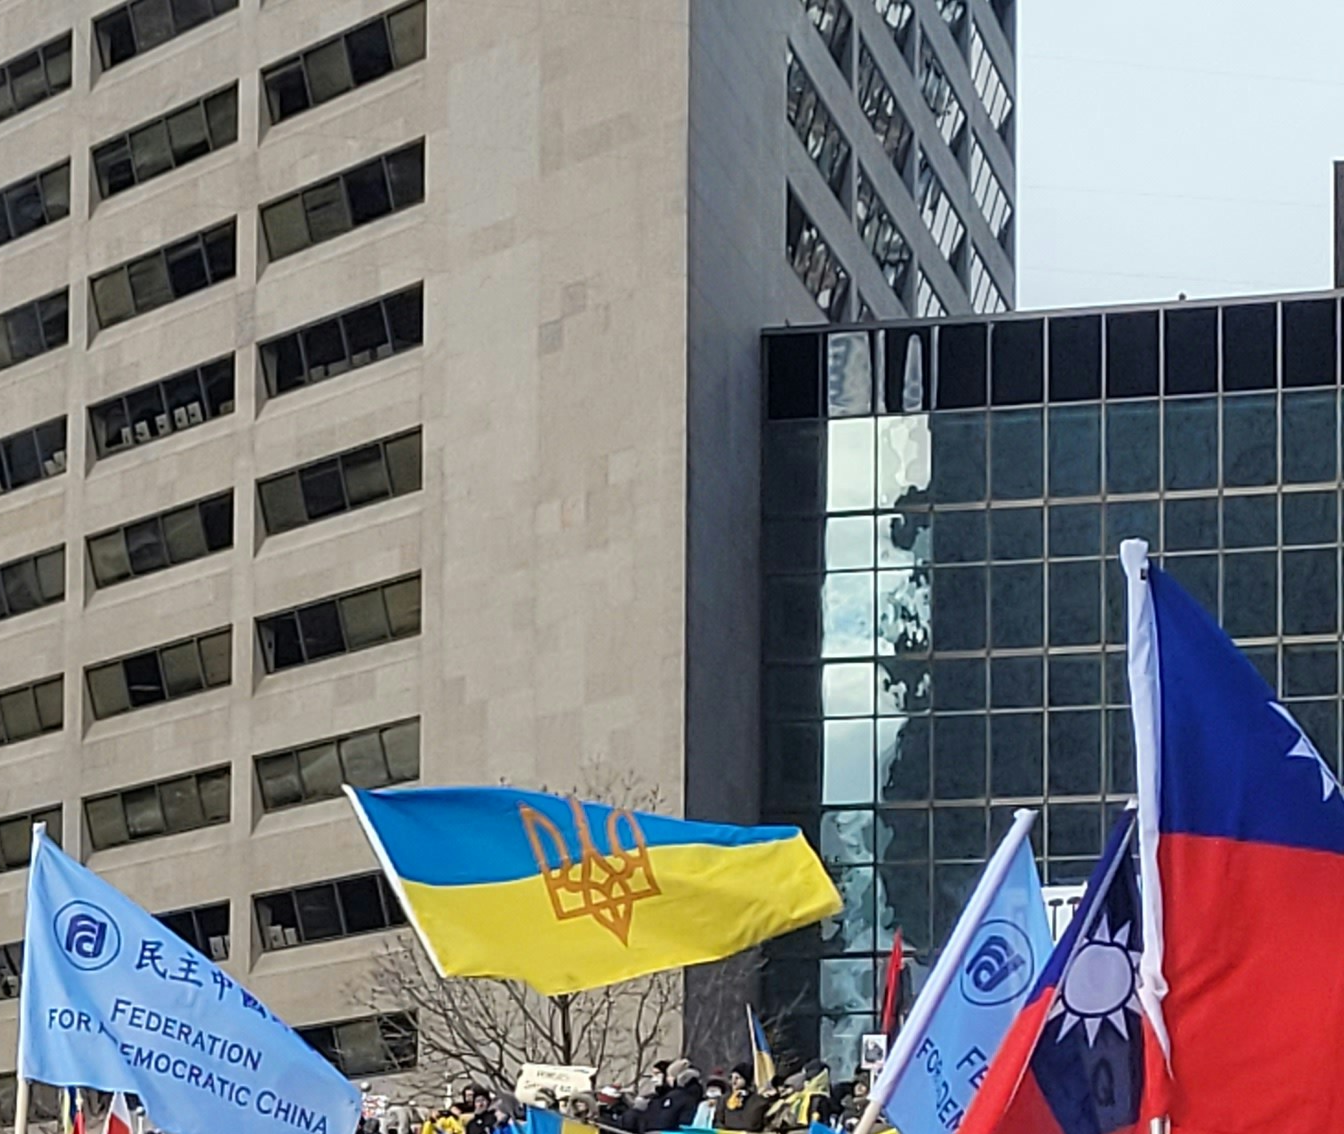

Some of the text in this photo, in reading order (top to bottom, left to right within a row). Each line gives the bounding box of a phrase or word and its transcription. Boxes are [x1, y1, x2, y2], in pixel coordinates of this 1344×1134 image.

[48, 1008, 92, 1031] FOR
[117, 1043, 252, 1107] EMOCRATIC
[111, 998, 262, 1072] FEDERATION
